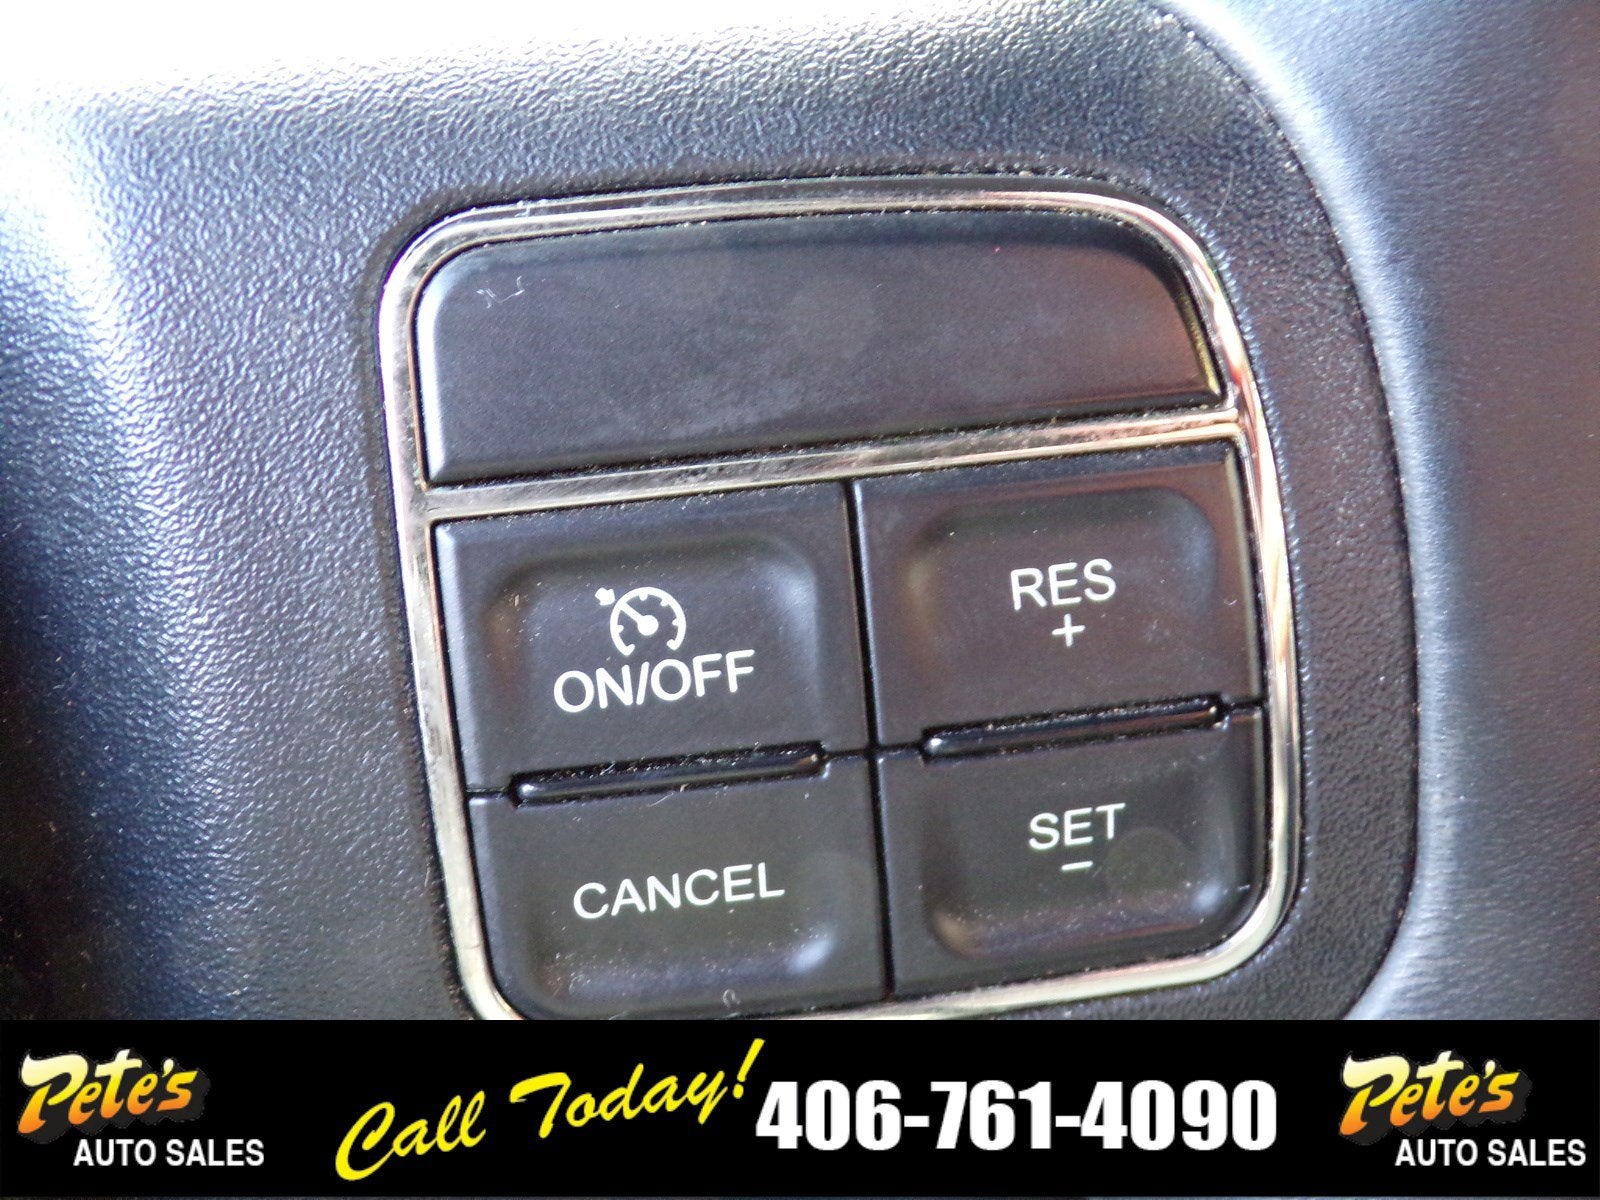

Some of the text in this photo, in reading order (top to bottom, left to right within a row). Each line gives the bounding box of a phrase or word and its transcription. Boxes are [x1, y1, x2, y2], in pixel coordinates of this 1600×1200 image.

[1010, 558, 1117, 611] RES
[553, 648, 756, 714] ON/OFF
[1028, 802, 1126, 850] SET
[572, 861, 786, 920] CANCEL
